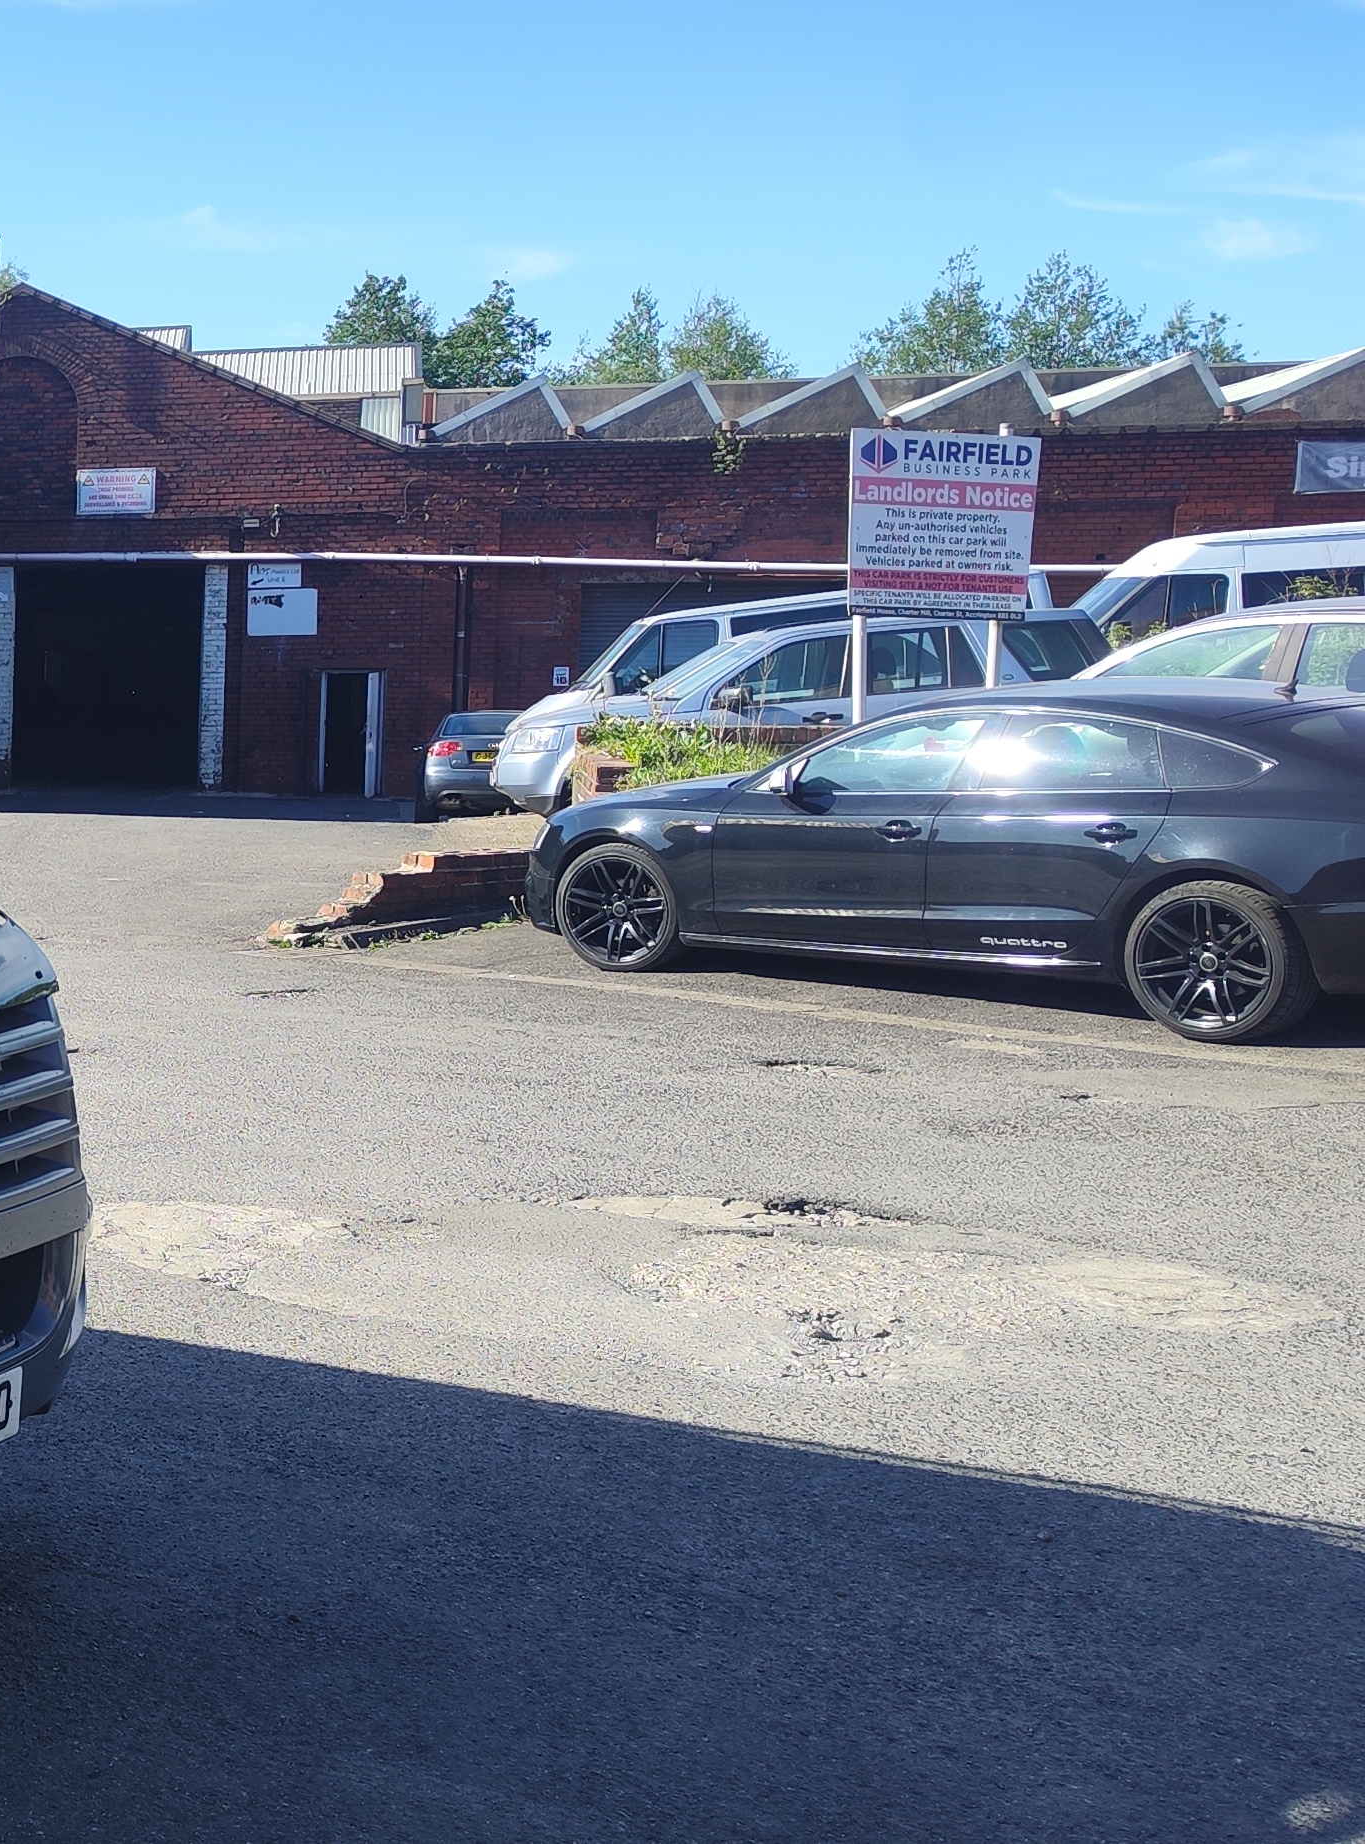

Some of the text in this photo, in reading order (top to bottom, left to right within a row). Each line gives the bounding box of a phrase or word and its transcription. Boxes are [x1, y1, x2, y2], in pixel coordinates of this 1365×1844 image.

[904, 439, 1032, 467] FAIRFIELD
[903, 463, 1032, 479] BUSINESS PARK
[96, 475, 136, 483] WARNING
[854, 480, 1033, 509] Landlords Notice
[885, 508, 1000, 524] This is private property.
[876, 520, 1007, 535] Any un-authorised vehicles
[875, 532, 909, 543] parked
[928, 534, 946, 544] this
[948, 537, 964, 545] car
[966, 536, 987, 547] park
[990, 537, 1007, 547] will
[855, 542, 1024, 560] immediately be removed from site.
[865, 556, 1014, 571] Vehicles parked at owners risk.
[853, 570, 1024, 584] THIS CAR PARK IS STRICTLY FOR CUSTOMERS
[863, 579, 895, 588] VISITING
[898, 581, 915, 589] SITE
[925, 582, 941, 590] NOT
[944, 583, 960, 591] FOR
[962, 583, 997, 593] TENANTS
[999, 585, 1013, 593] USE
[943, 593, 981, 601] ALLOCATED
[983, 594, 1010, 602] PARKING
[980, 936, 1067, 949] quattro
